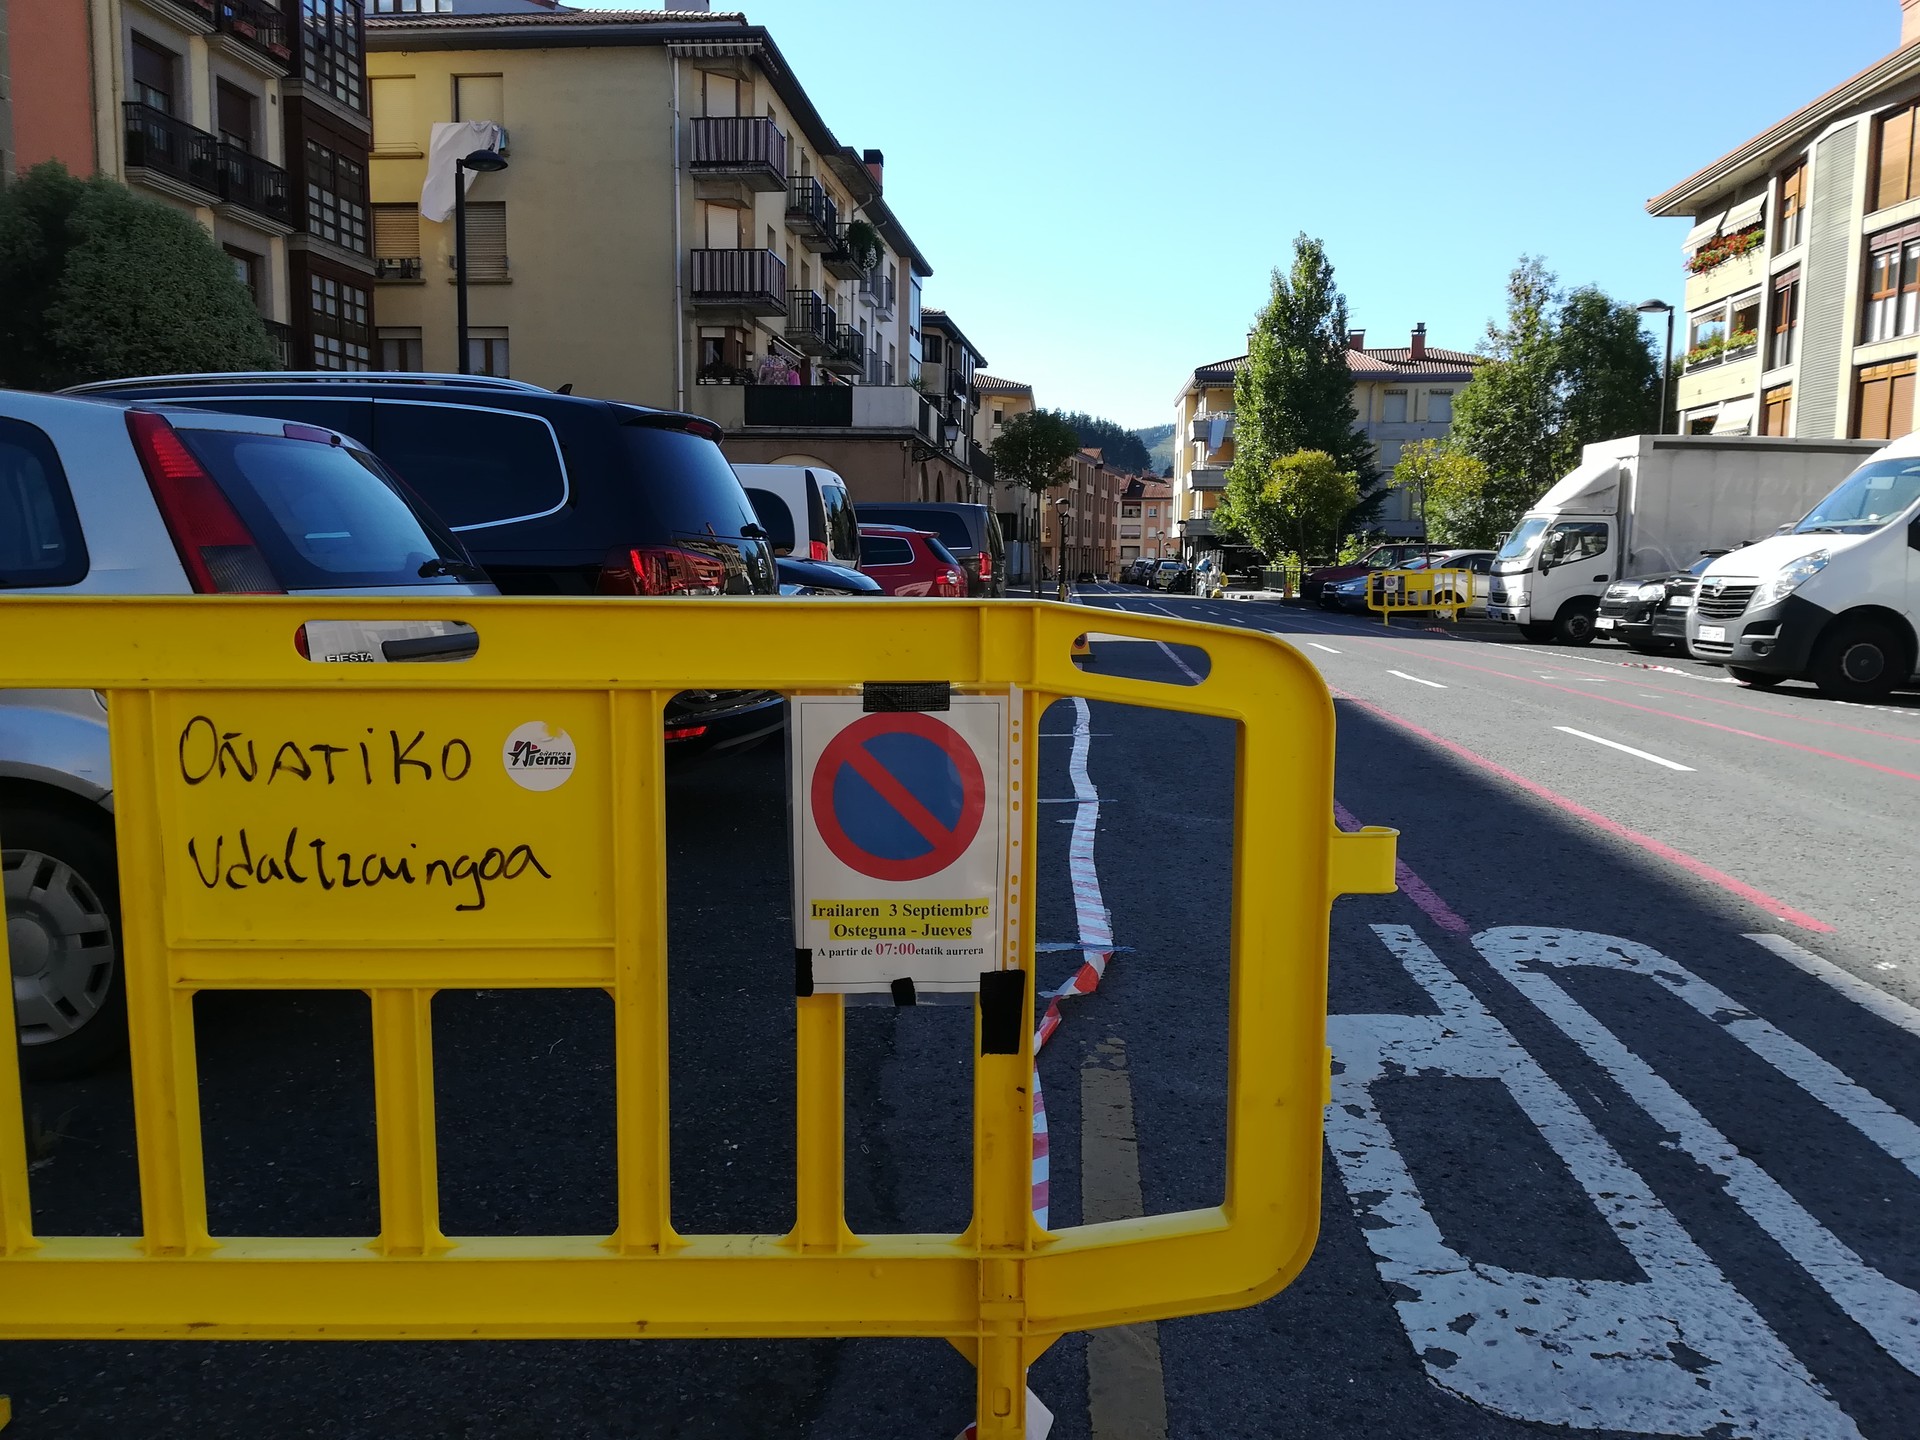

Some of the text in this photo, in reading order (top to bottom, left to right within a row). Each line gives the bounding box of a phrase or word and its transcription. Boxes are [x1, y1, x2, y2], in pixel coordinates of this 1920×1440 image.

[325, 653, 374, 663] FIESTA
[811, 902, 989, 920] Irailaren 3 Septiembre
[833, 923, 907, 939] Osteguna
[921, 923, 972, 937] Jueves
[817, 947, 826, 957] A
[829, 946, 858, 959] partir
[861, 947, 873, 956] de
[945, 947, 984, 957] aurrera
